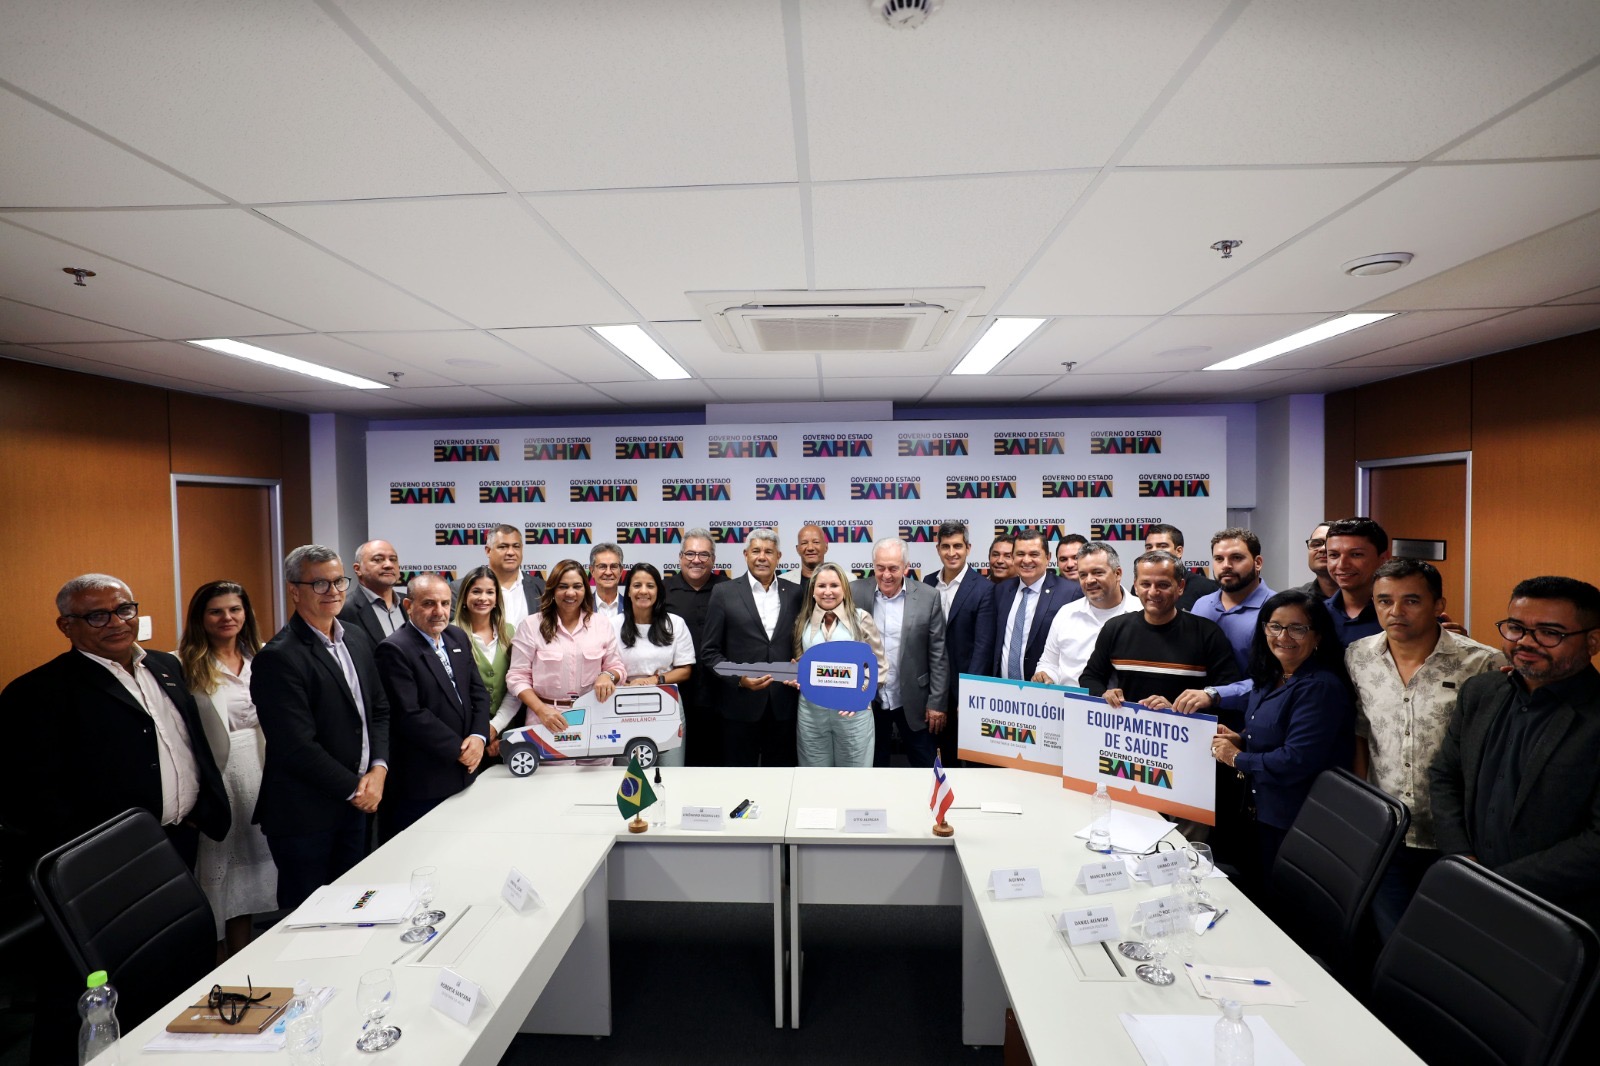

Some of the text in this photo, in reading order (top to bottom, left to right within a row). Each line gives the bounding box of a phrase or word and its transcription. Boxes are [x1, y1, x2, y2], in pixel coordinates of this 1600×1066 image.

[434, 445, 499, 462] BAHIA
[524, 444, 591, 460] BAHIA
[616, 442, 683, 459] BAHIA
[709, 441, 777, 458] BAHIA
[803, 440, 872, 457] BAHIA
[898, 439, 968, 456] BAHIA
[994, 438, 1064, 455] BAHIA
[1091, 437, 1161, 454] BAHIA
[390, 488, 455, 504] BAHIA
[479, 487, 545, 503] BAHIA
[570, 486, 637, 502] BAHIA
[662, 485, 730, 501] BAHIA
[756, 484, 825, 500] BAHIA
[851, 483, 920, 500] BAHIA
[946, 482, 1016, 498] BAHIA
[1042, 481, 1113, 498] BAHIA
[1139, 480, 1209, 497] BAHIA
[435, 529, 488, 545] BAHI
[525, 528, 592, 544] BAHIA
[617, 527, 684, 543] BAHIA
[822, 526, 873, 542] AHIA
[1091, 524, 1154, 541] BAHI
[817, 668, 852, 678] BAHIA
[969, 695, 986, 710] KIT
[981, 718, 1006, 726] GOVERNO
[1088, 710, 1189, 742] EQUIPAMENTOS
[981, 723, 1036, 744] BAHIA
[1105, 732, 1168, 759] DE SAÚDE
[1100, 750, 1132, 761] GOVERNO
[1146, 759, 1173, 770] ESTADO
[1099, 756, 1173, 789] BAHIA
